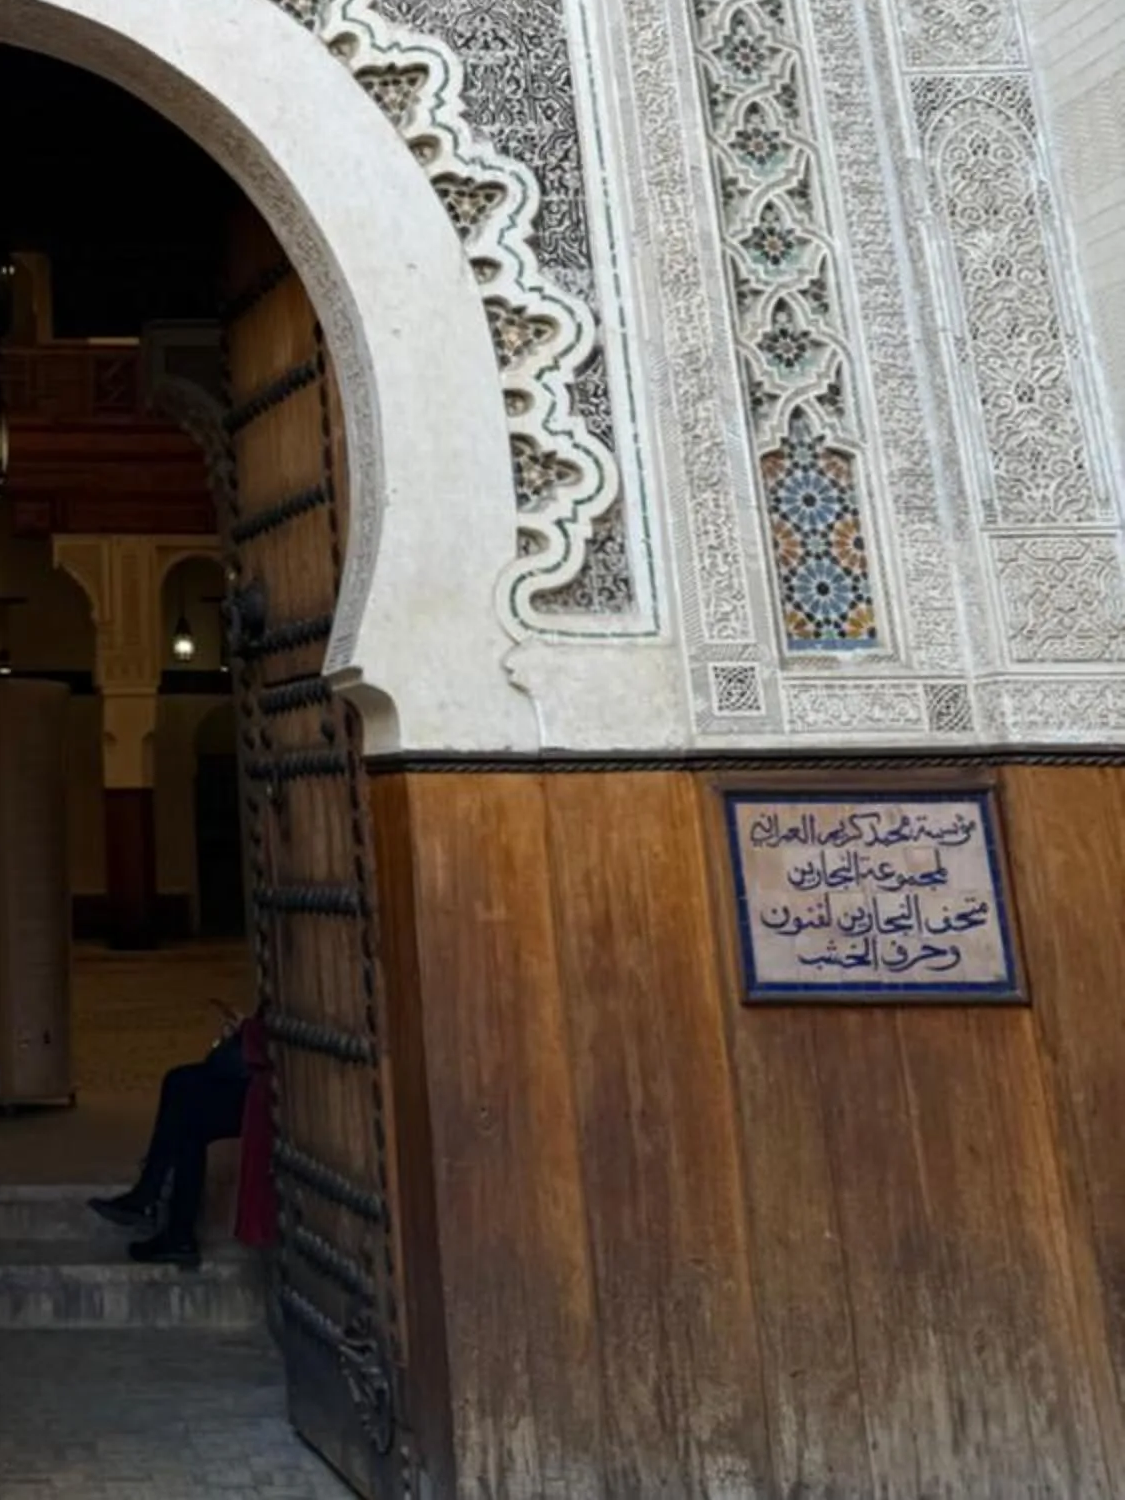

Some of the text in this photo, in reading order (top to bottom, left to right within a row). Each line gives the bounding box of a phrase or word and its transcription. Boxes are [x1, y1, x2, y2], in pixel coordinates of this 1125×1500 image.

[817, 813, 881, 847] كريم
[865, 815, 911, 847] محمد
[912, 813, 977, 846] مؤسسة
[787, 850, 860, 891] النجارين
[837, 893, 923, 937] النجارين
[925, 897, 990, 935] متحف
[798, 937, 962, 973] وحرف الخشب
